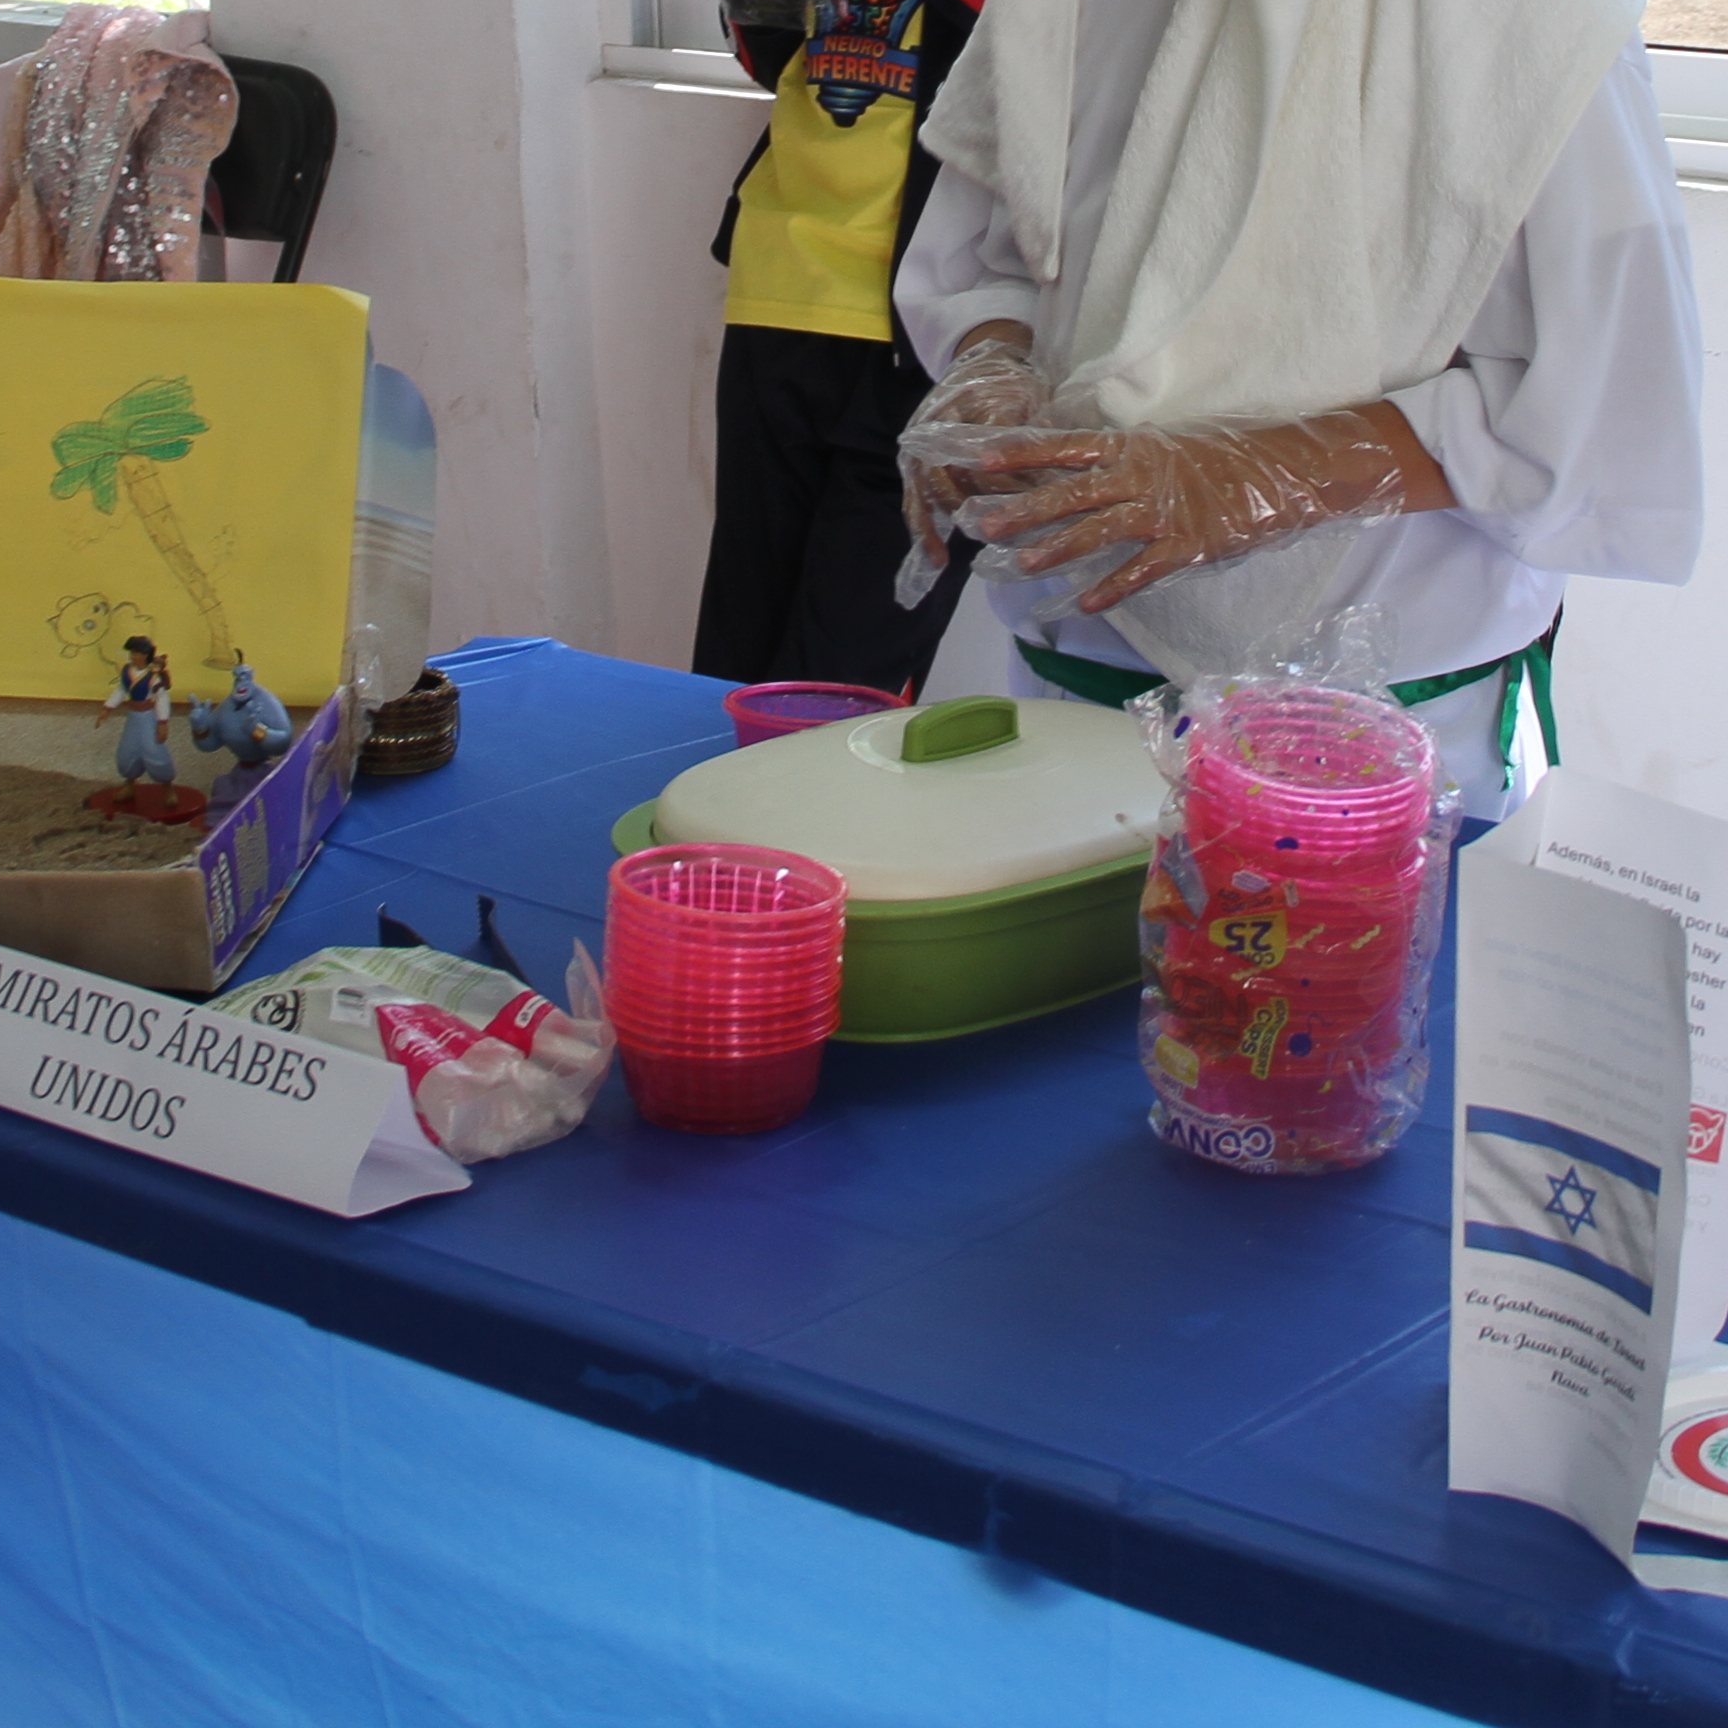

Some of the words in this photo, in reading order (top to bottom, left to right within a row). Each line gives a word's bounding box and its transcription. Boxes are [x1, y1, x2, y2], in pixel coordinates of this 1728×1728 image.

[823, 36, 887, 58] NEURO
[1547, 840, 1615, 876] Además,
[1618, 865, 1638, 882] en
[1640, 870, 1684, 898] Israel
[1685, 885, 1701, 903] la
[1223, 922, 1275, 953] 25
[1685, 915, 1713, 934] por
[1691, 940, 1722, 964] hay
[1690, 994, 1706, 1012] la
[157, 1007, 327, 1104] ÁRABES
[30, 1054, 187, 1140] UNIDOS
[1465, 1288, 1490, 1306] La
[1595, 1327, 1611, 1348] de
[1478, 1325, 1511, 1344] Por
[1513, 1331, 1558, 1358] Juan
[1559, 1346, 1600, 1376] Pablo
[1550, 1370, 1590, 1398] Nava
